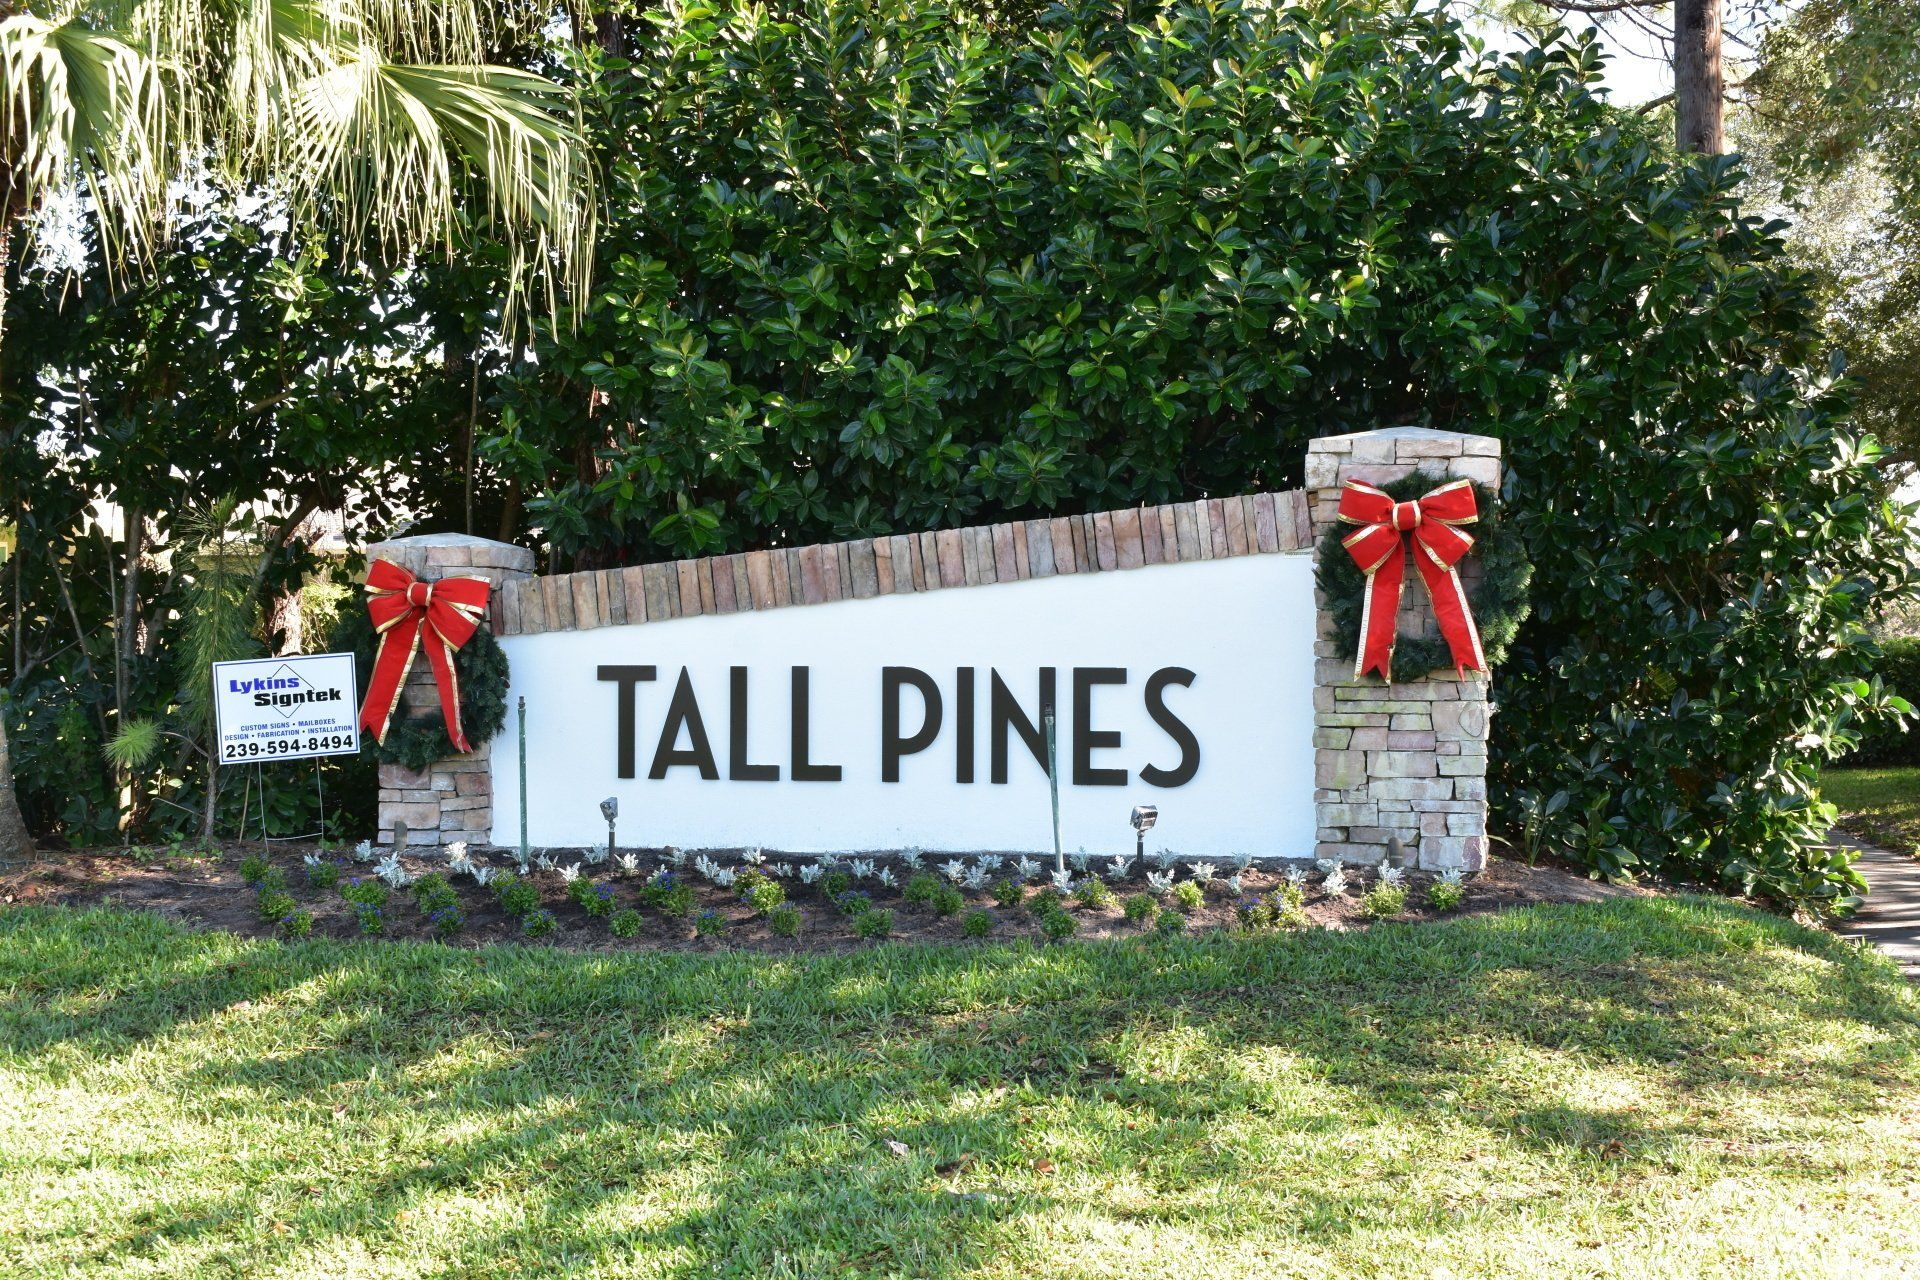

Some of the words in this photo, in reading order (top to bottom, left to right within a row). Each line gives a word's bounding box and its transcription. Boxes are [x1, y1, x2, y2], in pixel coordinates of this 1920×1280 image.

[229, 677, 300, 694] Lykins
[254, 687, 341, 707] Signtek
[224, 733, 249, 741] DESIGN
[257, 729, 300, 738] FABRICATION
[308, 725, 353, 734] INSTALLATION
[240, 723, 268, 732] CUSTOM
[270, 721, 290, 730] SIGNS
[298, 718, 336, 727] MAILBOXES
[597, 665, 842, 781] TALL
[882, 666, 1200, 788] PINES
[226, 734, 353, 758] 239-594-8494
